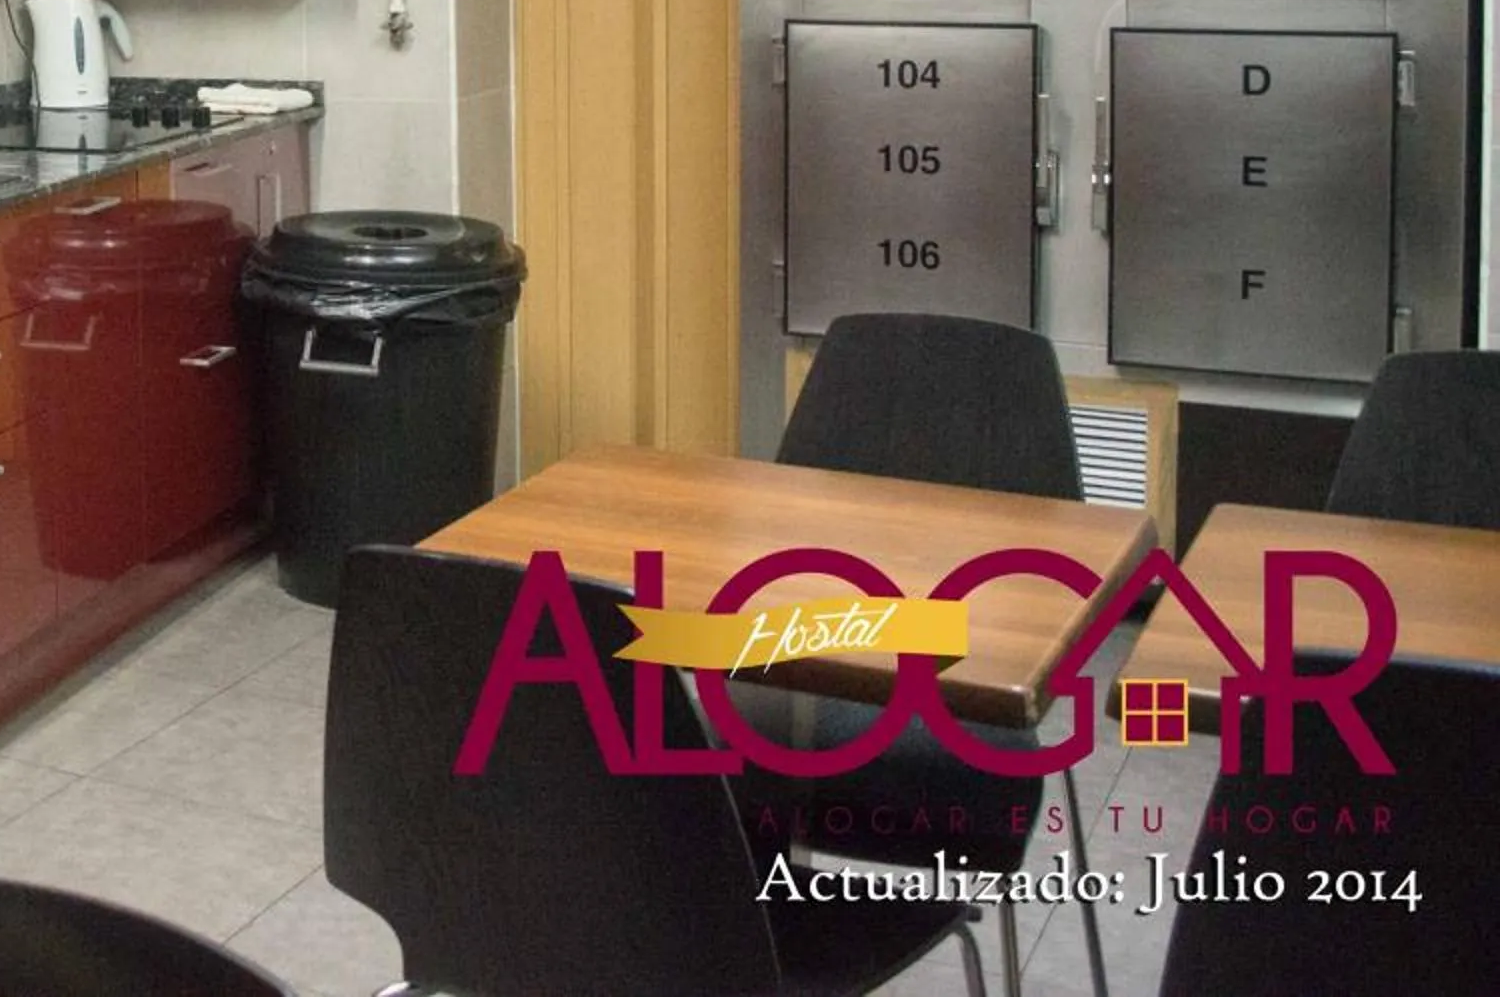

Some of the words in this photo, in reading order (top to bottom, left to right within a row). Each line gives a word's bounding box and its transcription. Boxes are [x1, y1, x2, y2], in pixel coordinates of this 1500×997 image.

[877, 59, 941, 90] 104
[1241, 64, 1272, 97] D
[877, 144, 941, 176] 105
[1241, 155, 1268, 188] E
[877, 238, 941, 271] 106
[1241, 269, 1267, 300] F
